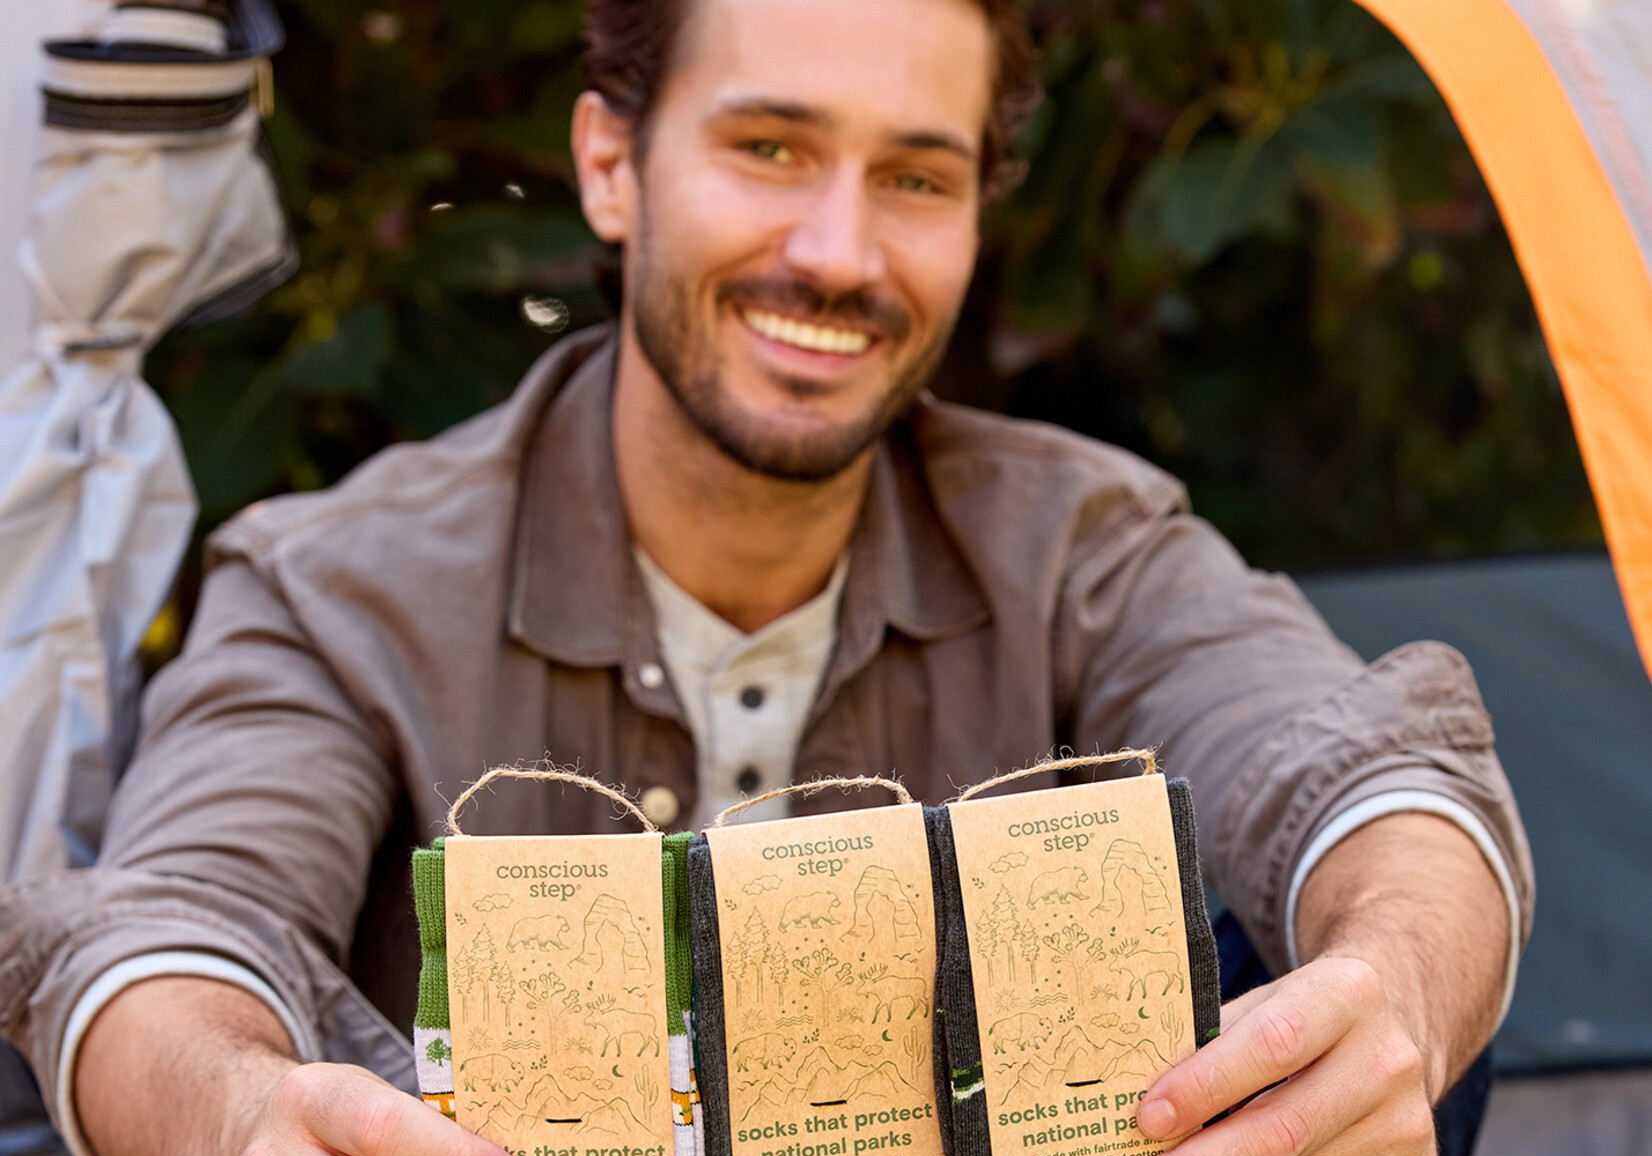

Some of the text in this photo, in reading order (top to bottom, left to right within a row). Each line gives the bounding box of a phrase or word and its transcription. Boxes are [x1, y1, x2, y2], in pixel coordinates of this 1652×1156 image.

[1008, 809, 1120, 838] conscious
[762, 835, 874, 861] conscious
[496, 860, 608, 879] conscious
[737, 1103, 934, 1143] socks that protect
[998, 1103, 1059, 1127] socks
[1064, 1093, 1109, 1115] that
[853, 1131, 913, 1156] parks
[1022, 1117, 1108, 1147] national
[1094, 1138, 1140, 1154] fairtrade
[1143, 1138, 1163, 1146] an
